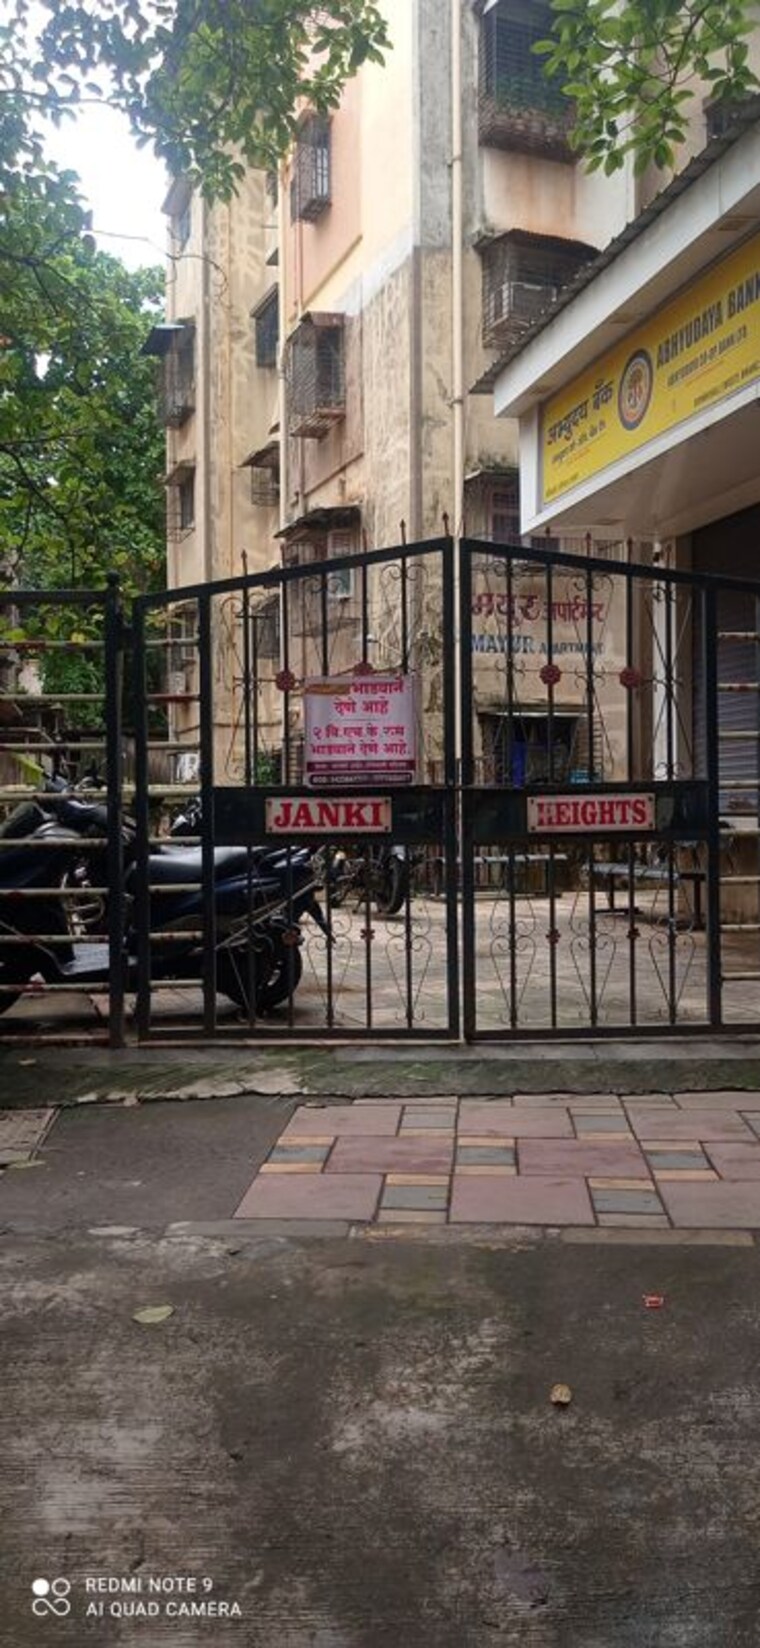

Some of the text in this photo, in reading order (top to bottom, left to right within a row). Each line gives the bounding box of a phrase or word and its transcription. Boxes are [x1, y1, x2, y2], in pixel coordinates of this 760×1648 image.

[657, 301, 723, 369] ABHYUDAYA
[471, 634, 536, 654] MAYUR
[362, 696, 389, 715] आहे
[274, 802, 383, 827] JANKI
[537, 799, 647, 826] HEIGHTS
